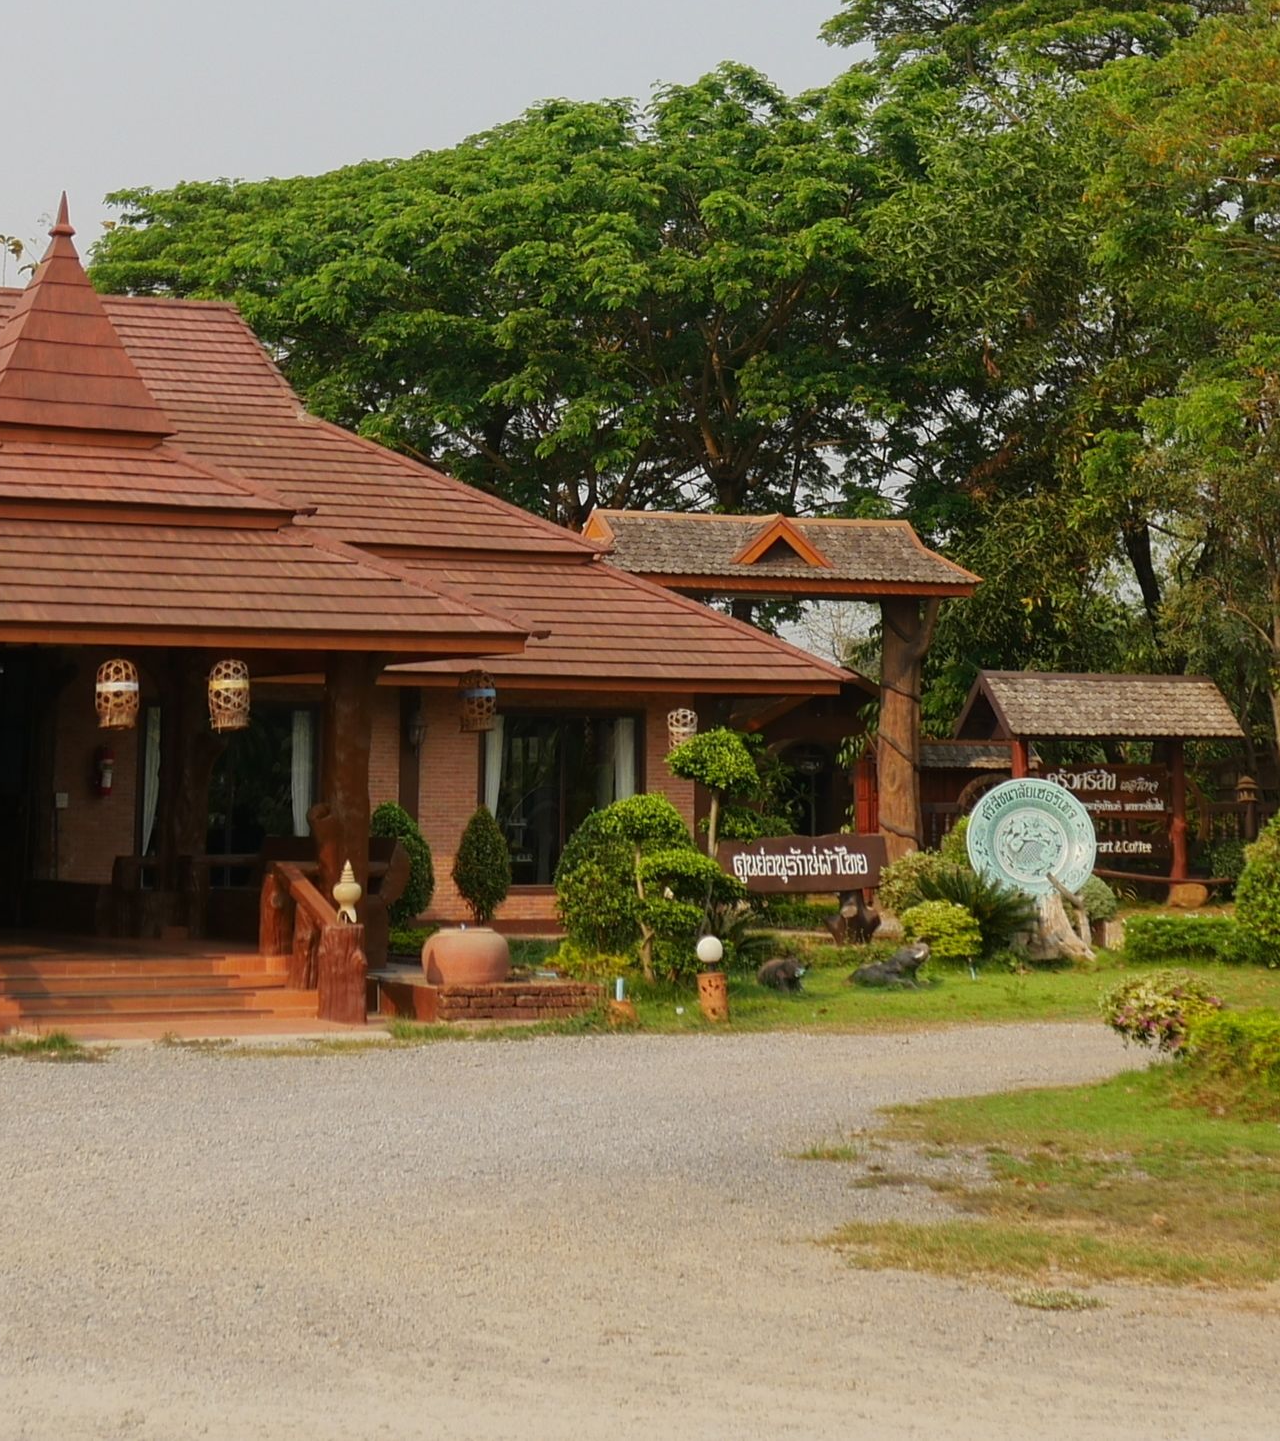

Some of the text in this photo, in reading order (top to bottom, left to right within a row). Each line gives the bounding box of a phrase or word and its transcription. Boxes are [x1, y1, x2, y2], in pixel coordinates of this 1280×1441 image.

[981, 782, 1078, 821] ศรีสัชนาลัยเฮอริเทจ
[732, 845, 869, 884] ศูนย์อนุรักษ์ผ้าไทย
[1122, 839, 1153, 855] Coffee
